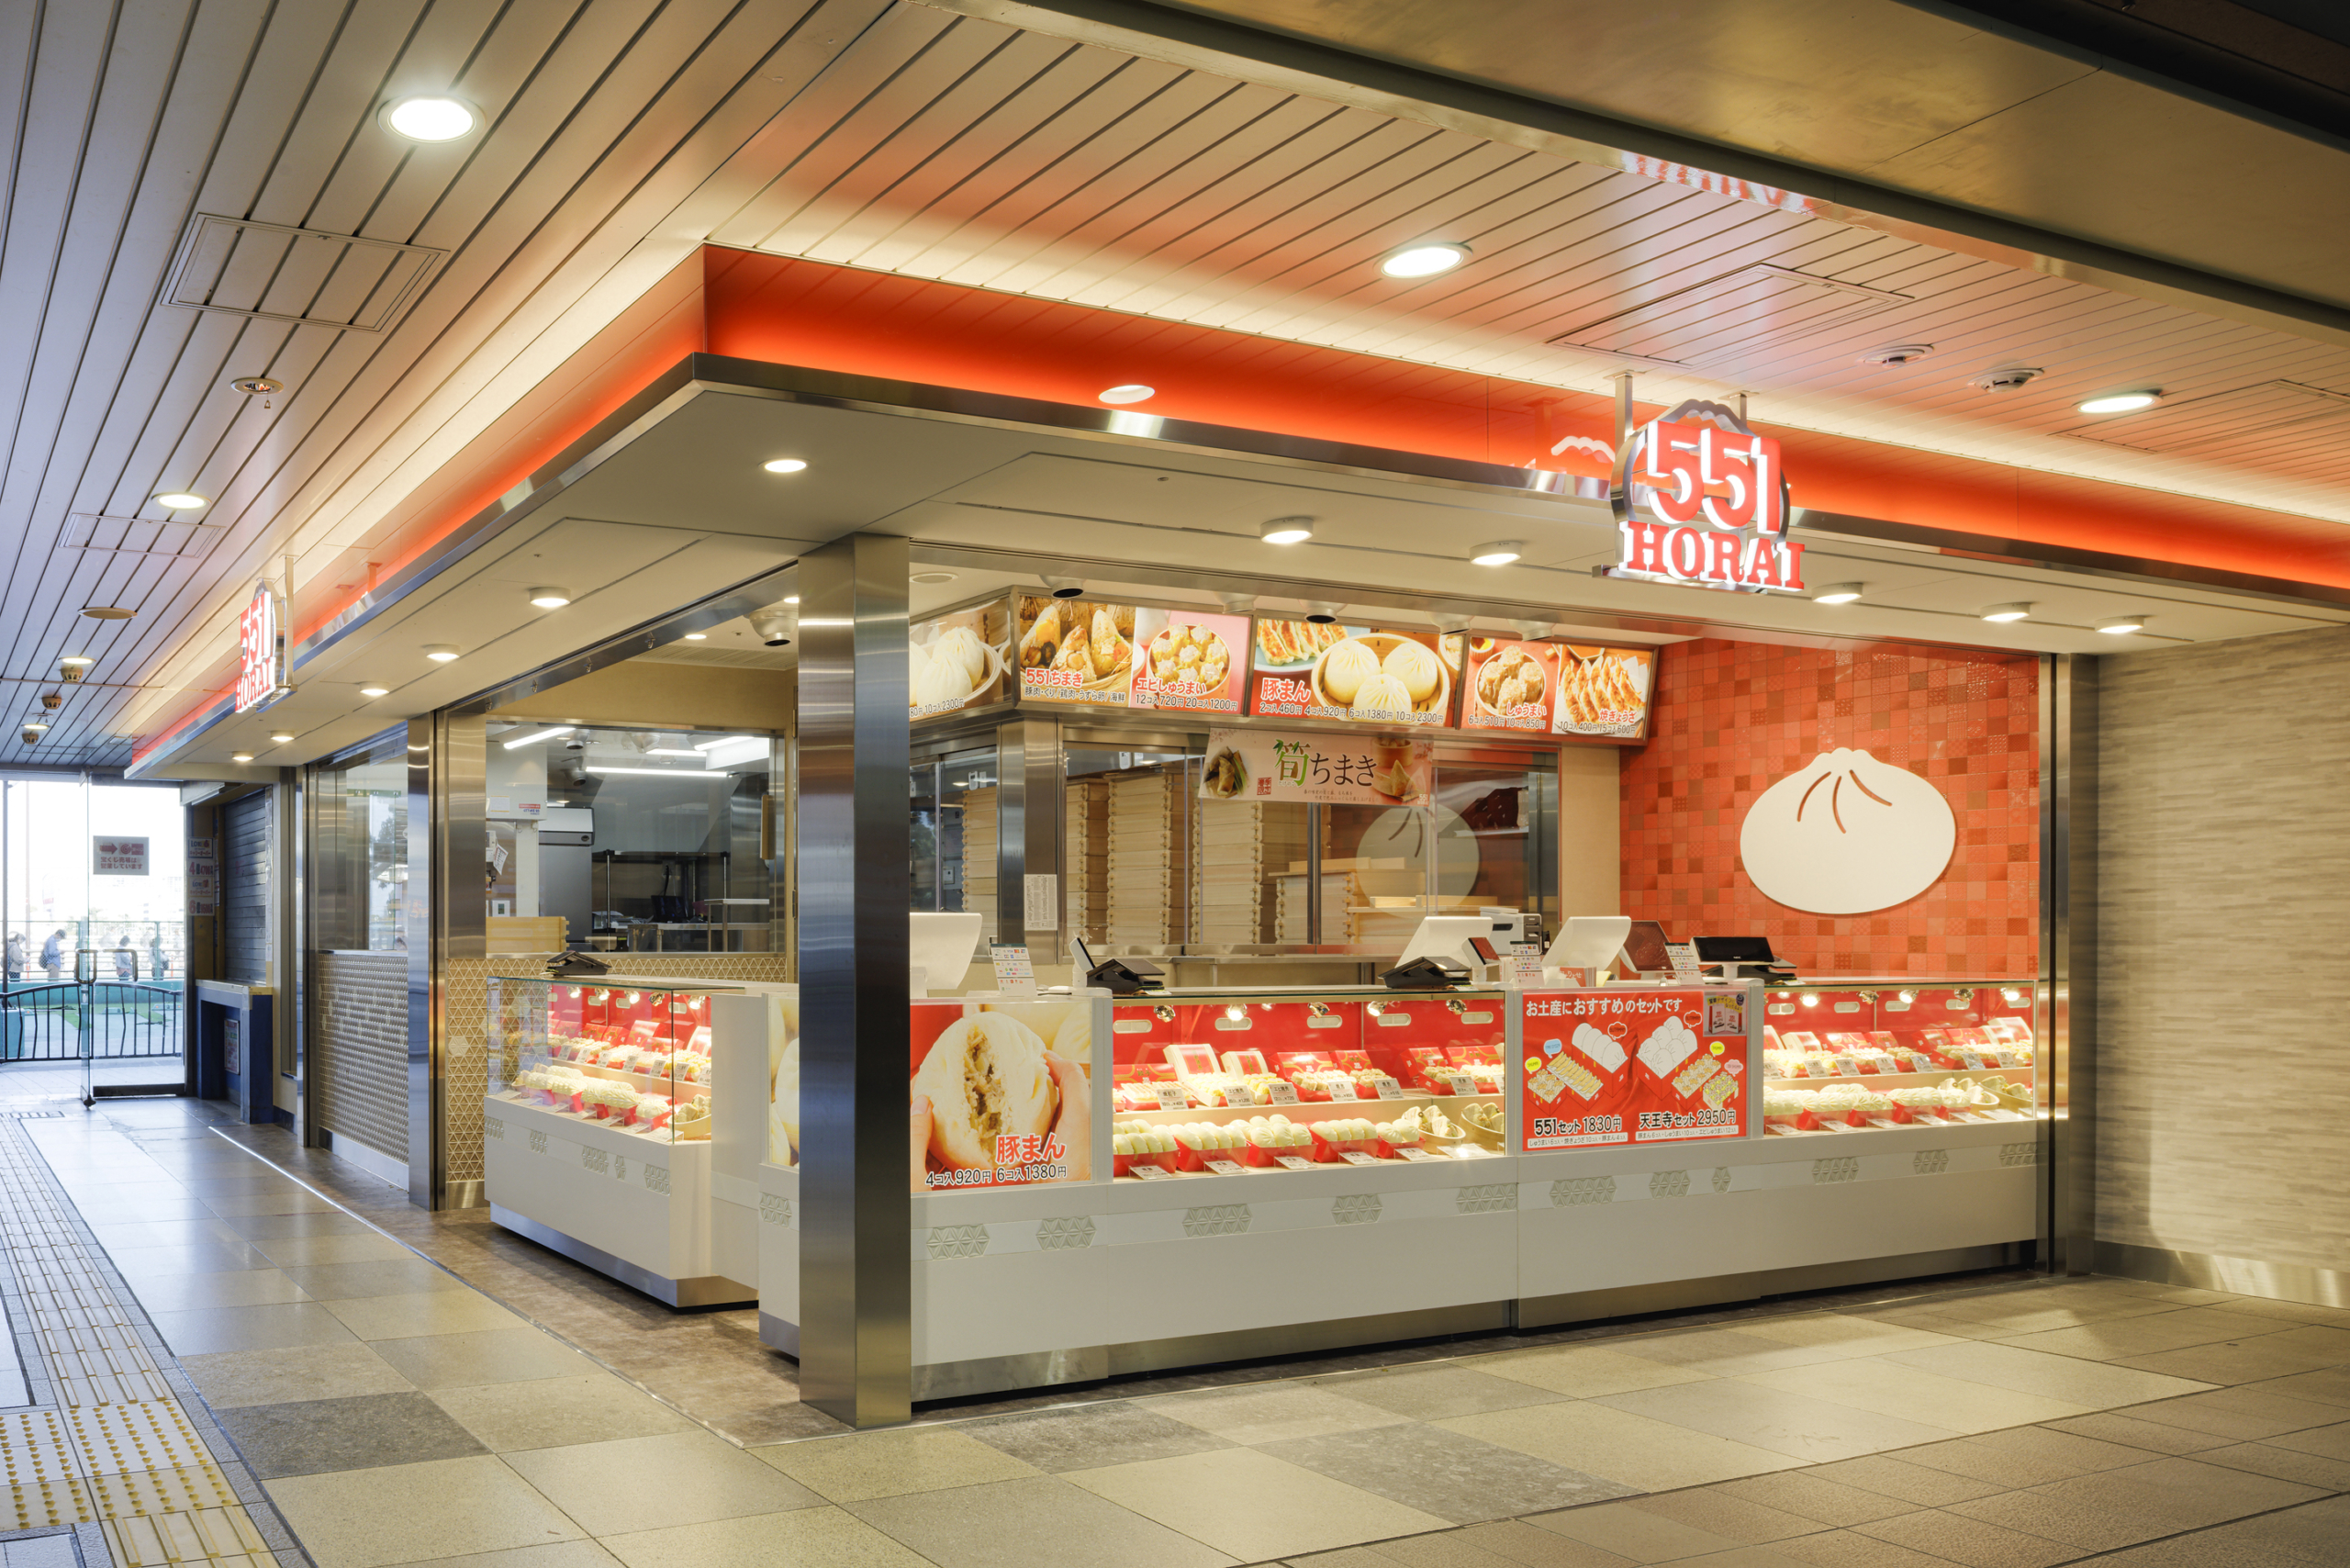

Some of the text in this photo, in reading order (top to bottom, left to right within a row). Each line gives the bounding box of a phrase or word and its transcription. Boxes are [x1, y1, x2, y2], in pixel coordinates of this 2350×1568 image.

[1648, 420, 1781, 534] 551
[1618, 521, 1805, 592] HORAI
[241, 592, 271, 673] 551
[235, 657, 276, 712] HORAI
[1026, 668, 1082, 687] 551ちまき
[1137, 678, 1206, 694] エビしゅうまい
[1262, 678, 1310, 701] 豚まん
[910, 706, 923, 717] 80円
[1507, 703, 1547, 717] しゅうまい
[1600, 710, 1636, 722] 焼ぎょうざ
[1273, 739, 1377, 787] 筍ちまき
[1526, 998, 1683, 1017] お土産におすすめのセットです
[1535, 1114, 1622, 1137] 551セット 1830円
[1639, 1109, 1736, 1128] 天王寺セット 2950円
[996, 1134, 1066, 1163] 豚まん
[925, 1164, 1067, 1187] 4コ入920円 6コ入1380円
